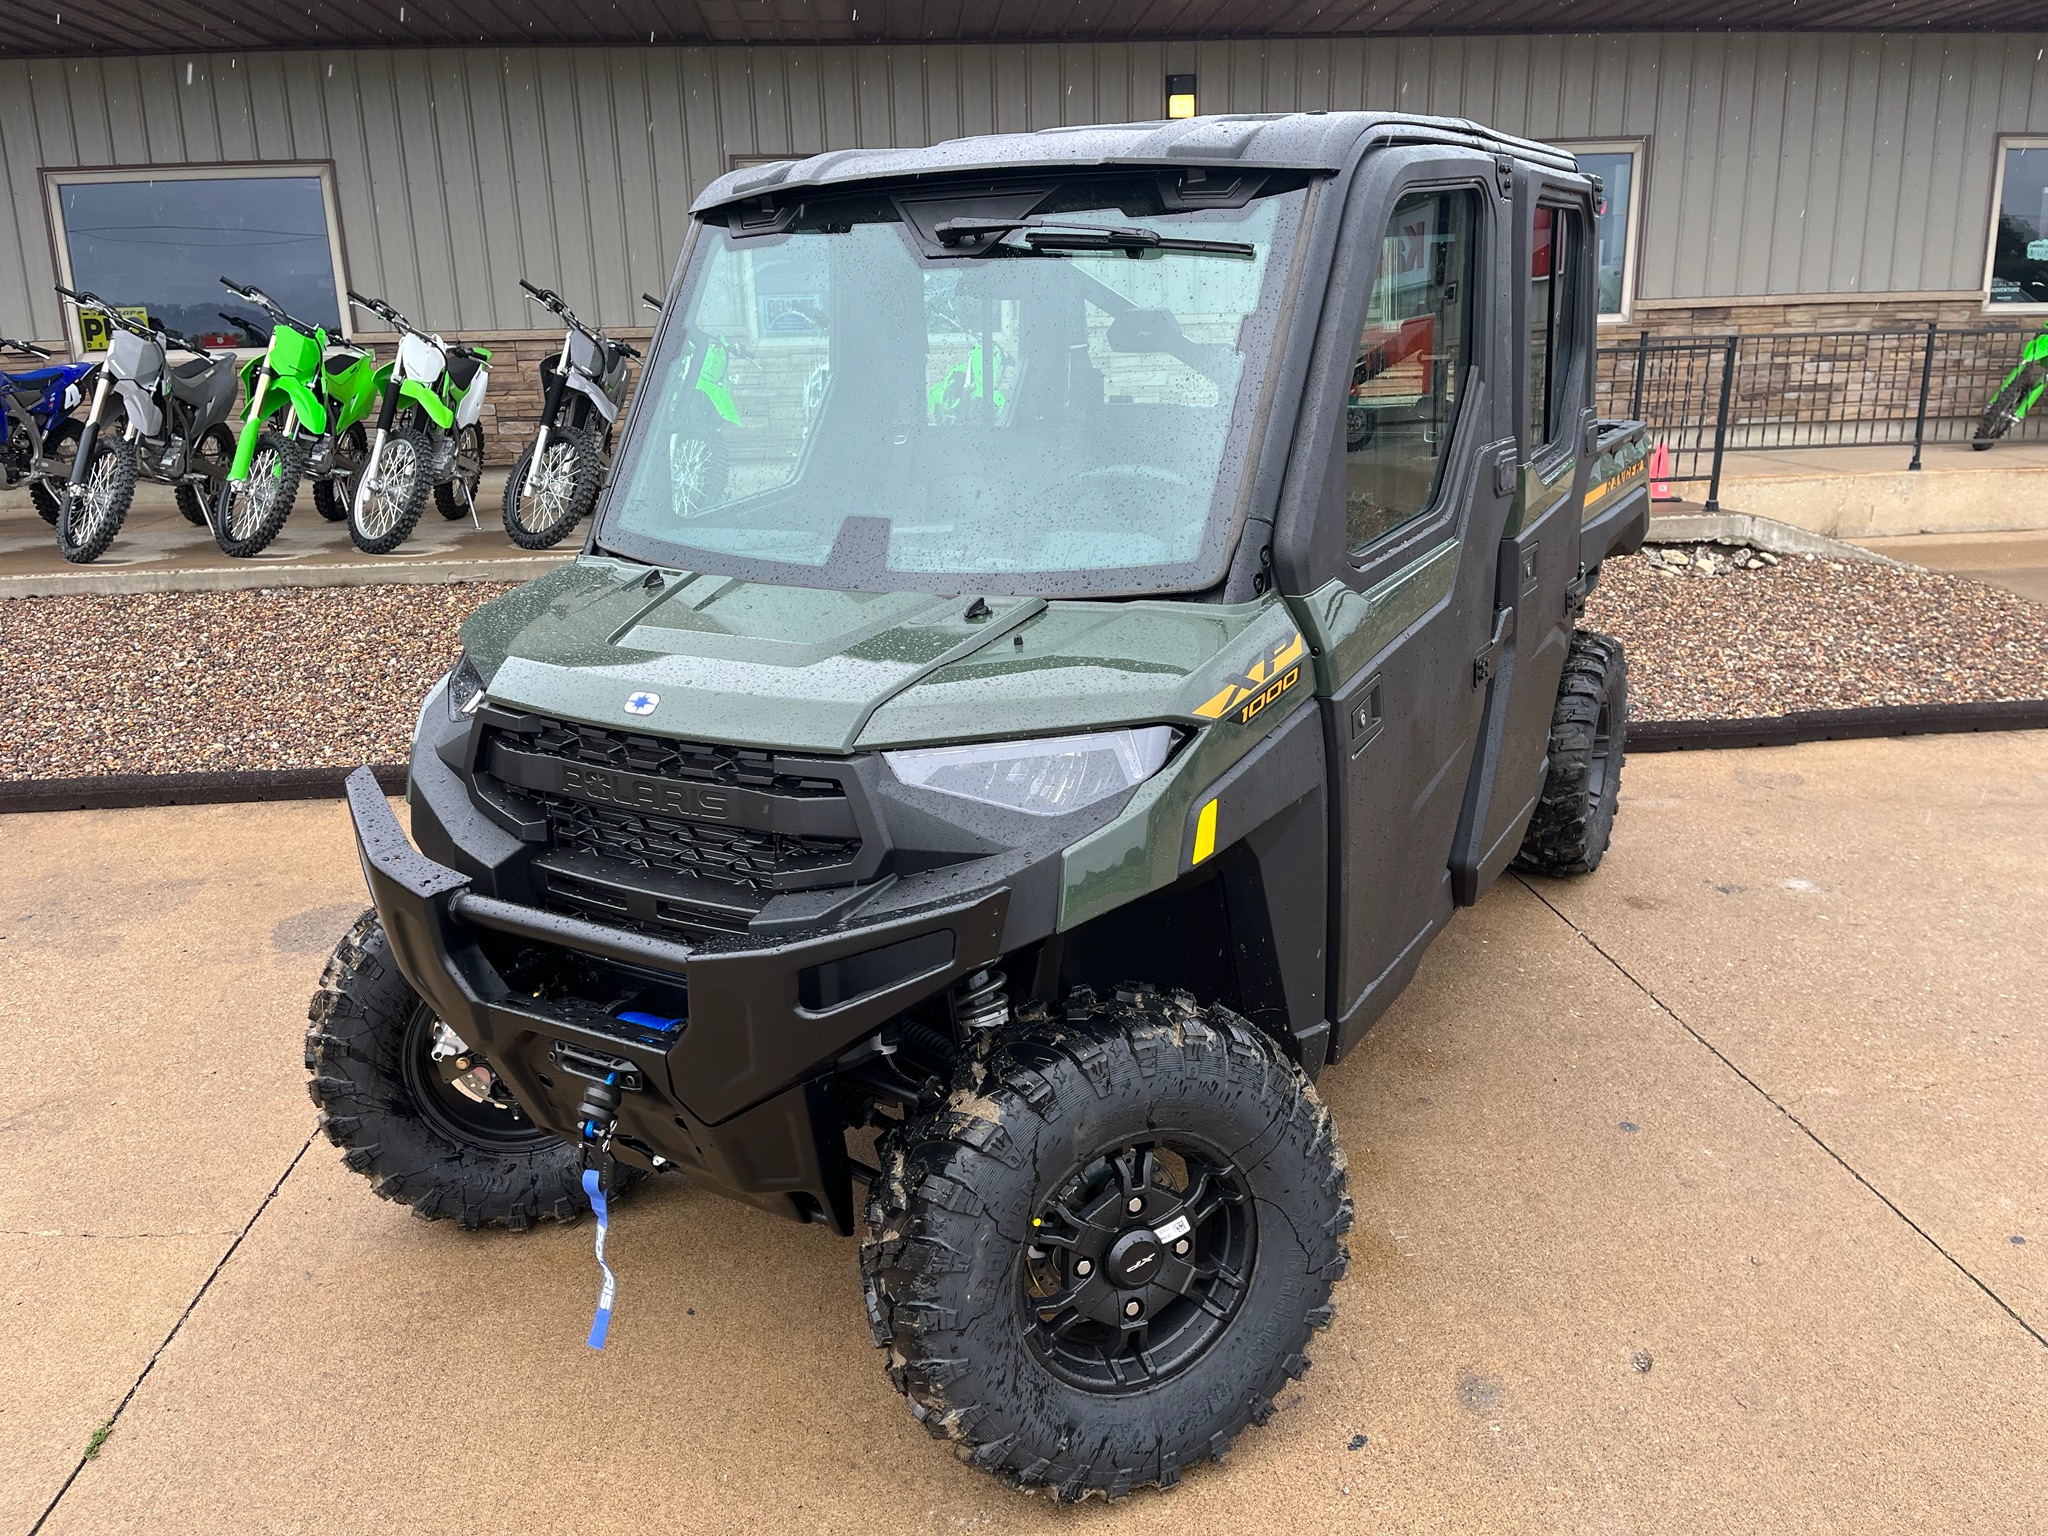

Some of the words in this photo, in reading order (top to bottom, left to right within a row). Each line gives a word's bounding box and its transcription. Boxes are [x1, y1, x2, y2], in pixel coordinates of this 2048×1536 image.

[64, 383, 81, 410] 4
[1218, 630, 1298, 714] XP
[1242, 667, 1299, 723] 1000
[562, 765, 730, 820] POLARIS
